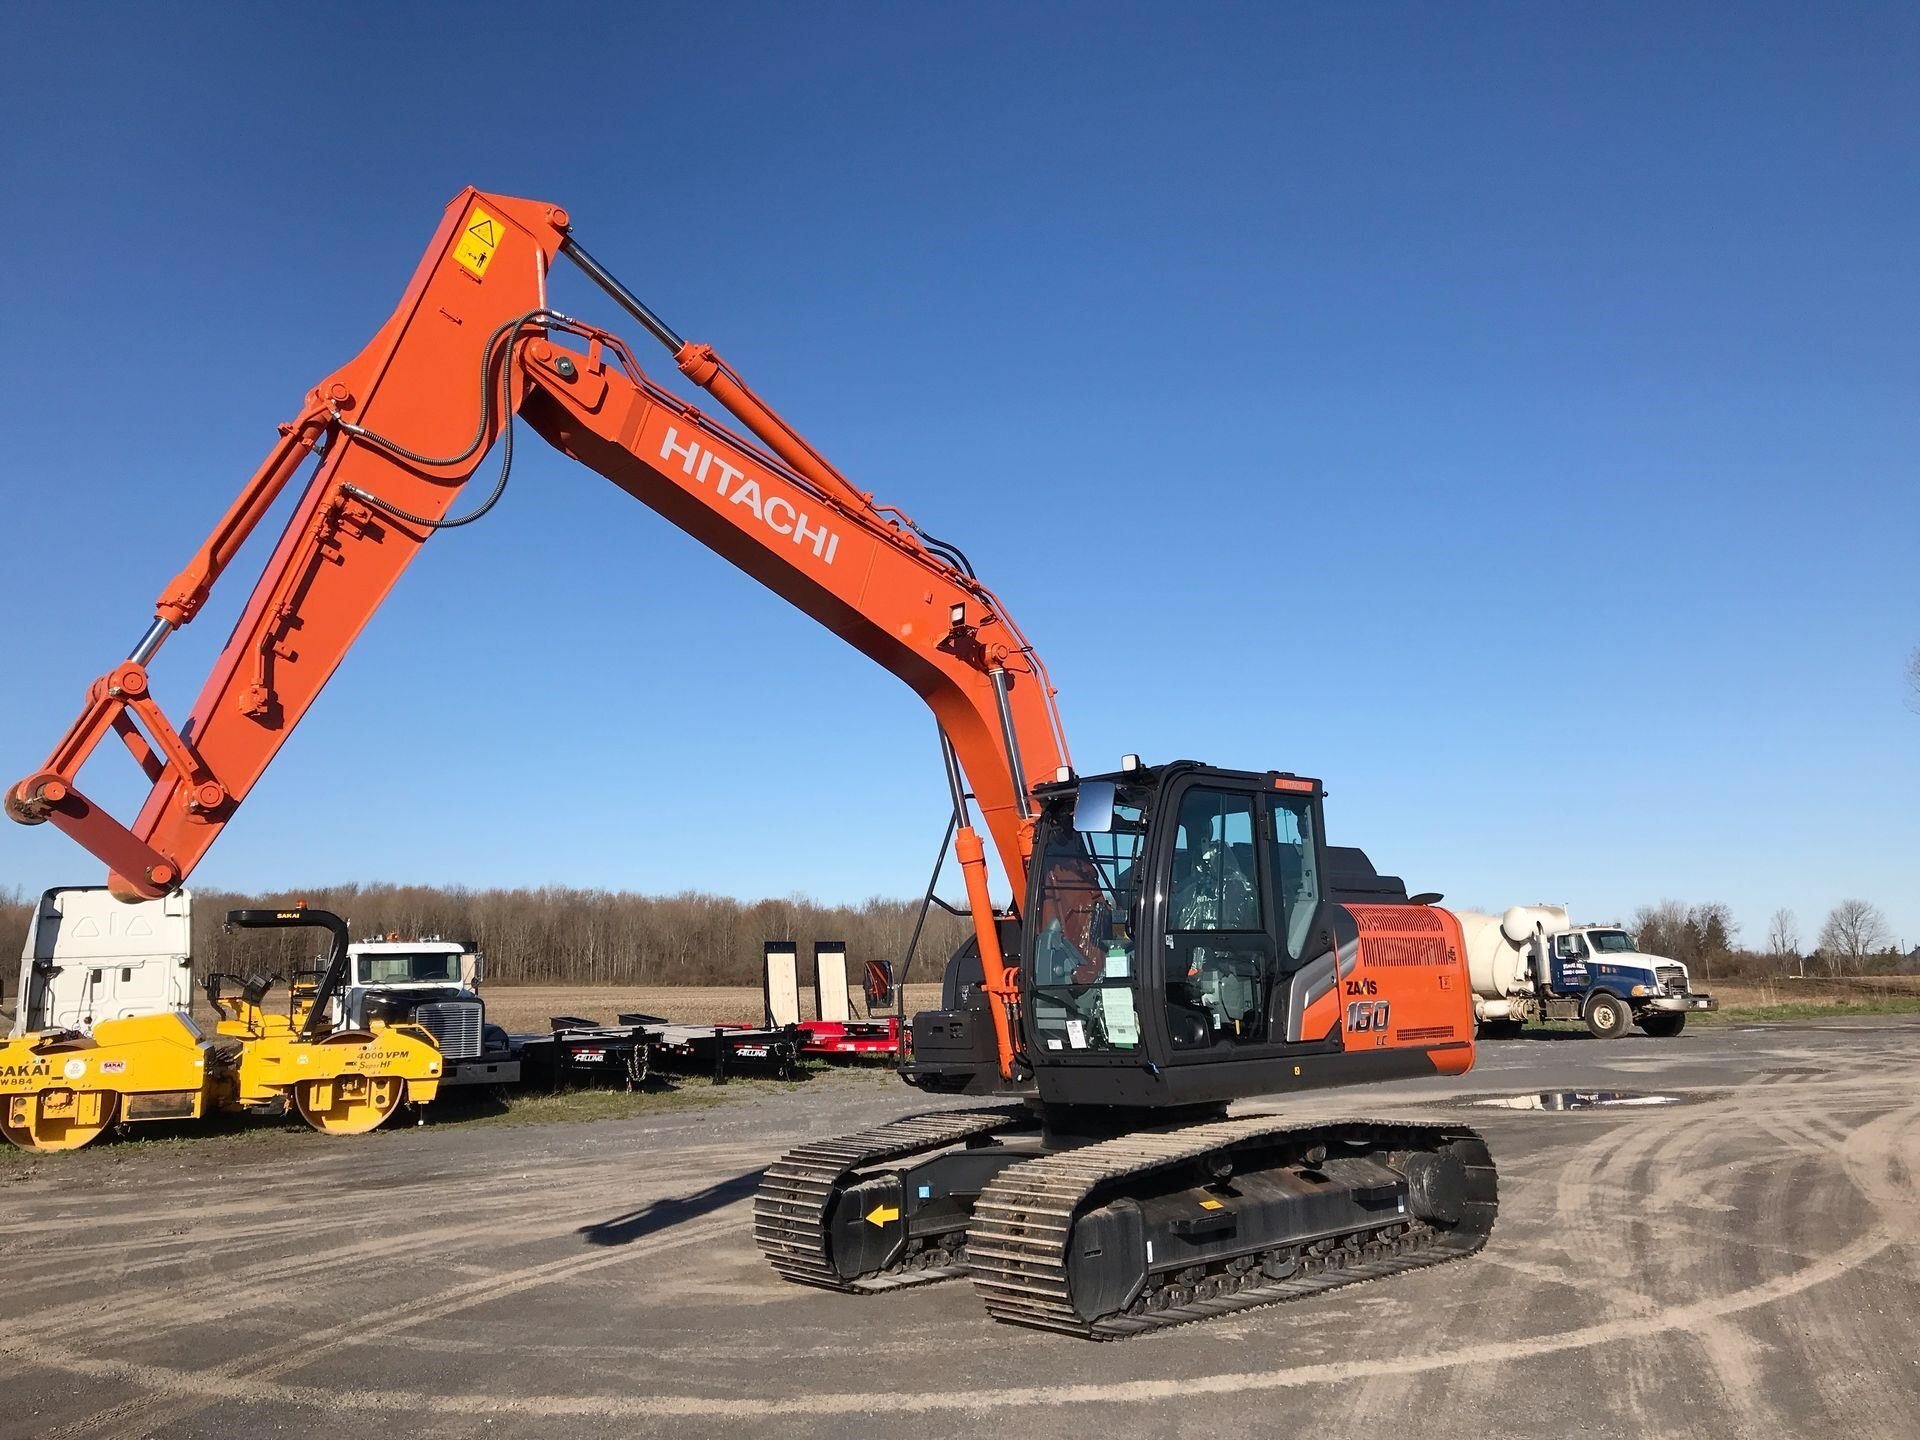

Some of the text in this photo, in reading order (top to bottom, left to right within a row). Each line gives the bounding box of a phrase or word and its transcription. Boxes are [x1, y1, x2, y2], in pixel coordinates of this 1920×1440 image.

[660, 427, 840, 565] HITACHI
[1346, 1000, 1391, 1033] 160
[356, 1050, 410, 1060] 4000 VPM
